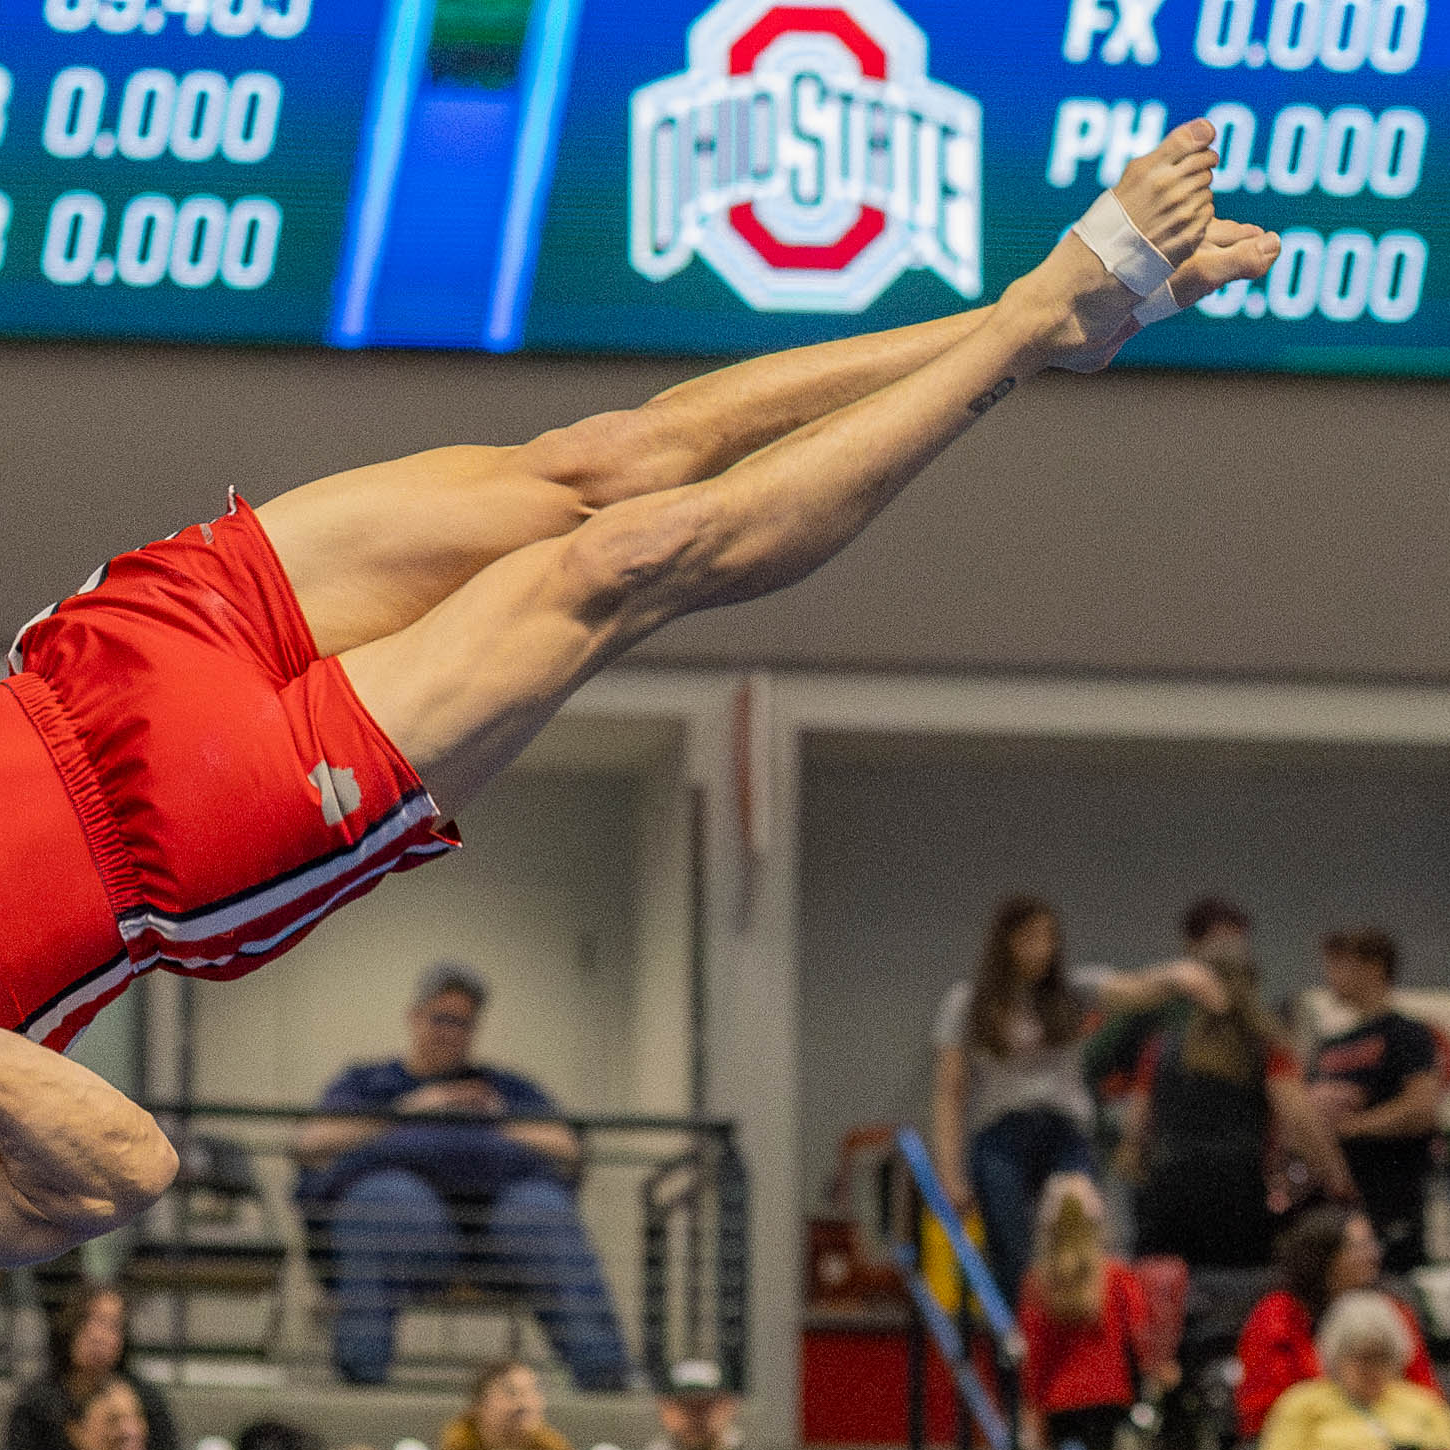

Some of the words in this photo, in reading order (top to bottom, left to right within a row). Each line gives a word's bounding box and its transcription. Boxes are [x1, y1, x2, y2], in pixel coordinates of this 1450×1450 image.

[1062, 0, 1159, 64] FX
[1194, 0, 1423, 74] 0.000
[43, 67, 283, 162] 0.000
[1047, 97, 1168, 188] PH
[1206, 102, 1429, 195] 0.000
[42, 189, 283, 289] 0.000
[1196, 228, 1429, 322] .000
